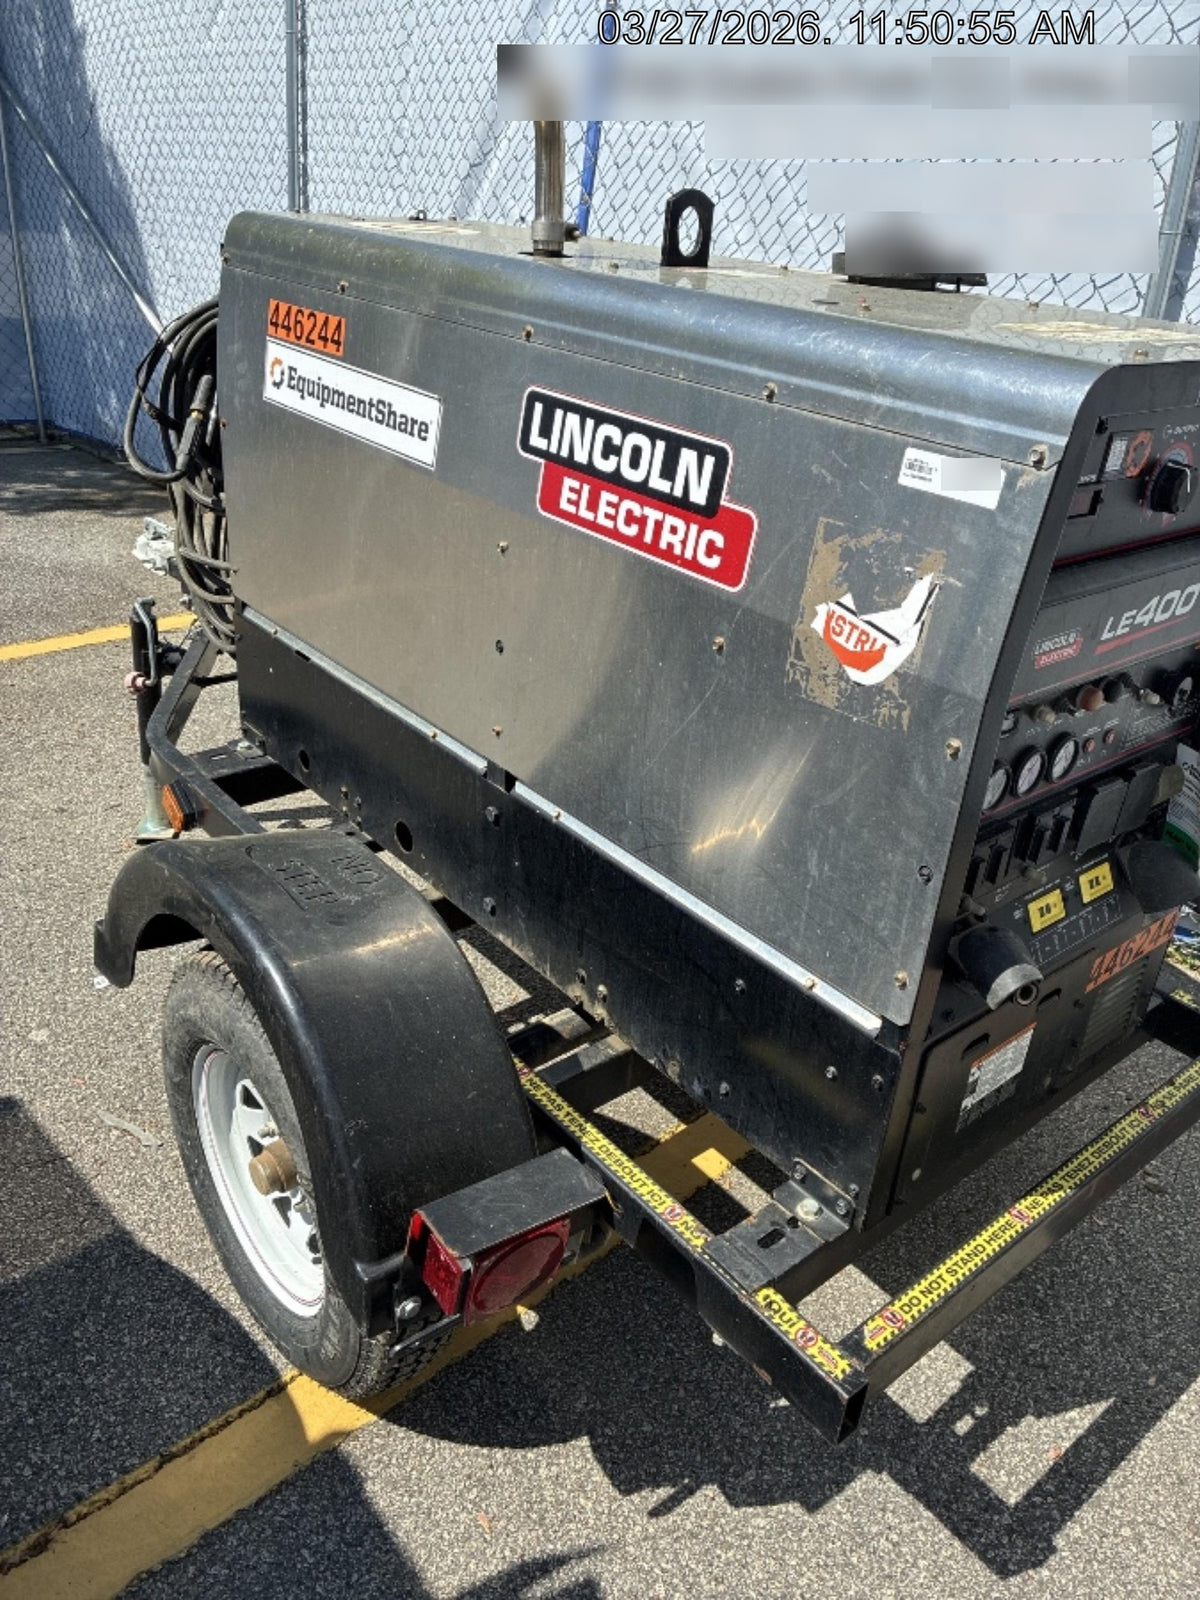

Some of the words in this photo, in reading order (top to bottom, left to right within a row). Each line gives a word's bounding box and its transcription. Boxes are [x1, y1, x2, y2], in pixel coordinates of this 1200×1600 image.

[269, 301, 343, 353] 446244
[287, 365, 429, 442] EquipmentShare
[528, 401, 716, 506] LINCOLN
[559, 476, 725, 569] ELECTRIC
[564, 1110, 601, 1143] TENEZ
[599, 1144, 650, 1189] DEBOUT
[899, 1295, 922, 1315] DO
[919, 1274, 948, 1299] NOT
[945, 1243, 986, 1277] STAND
[984, 1218, 1018, 1246] HERE
